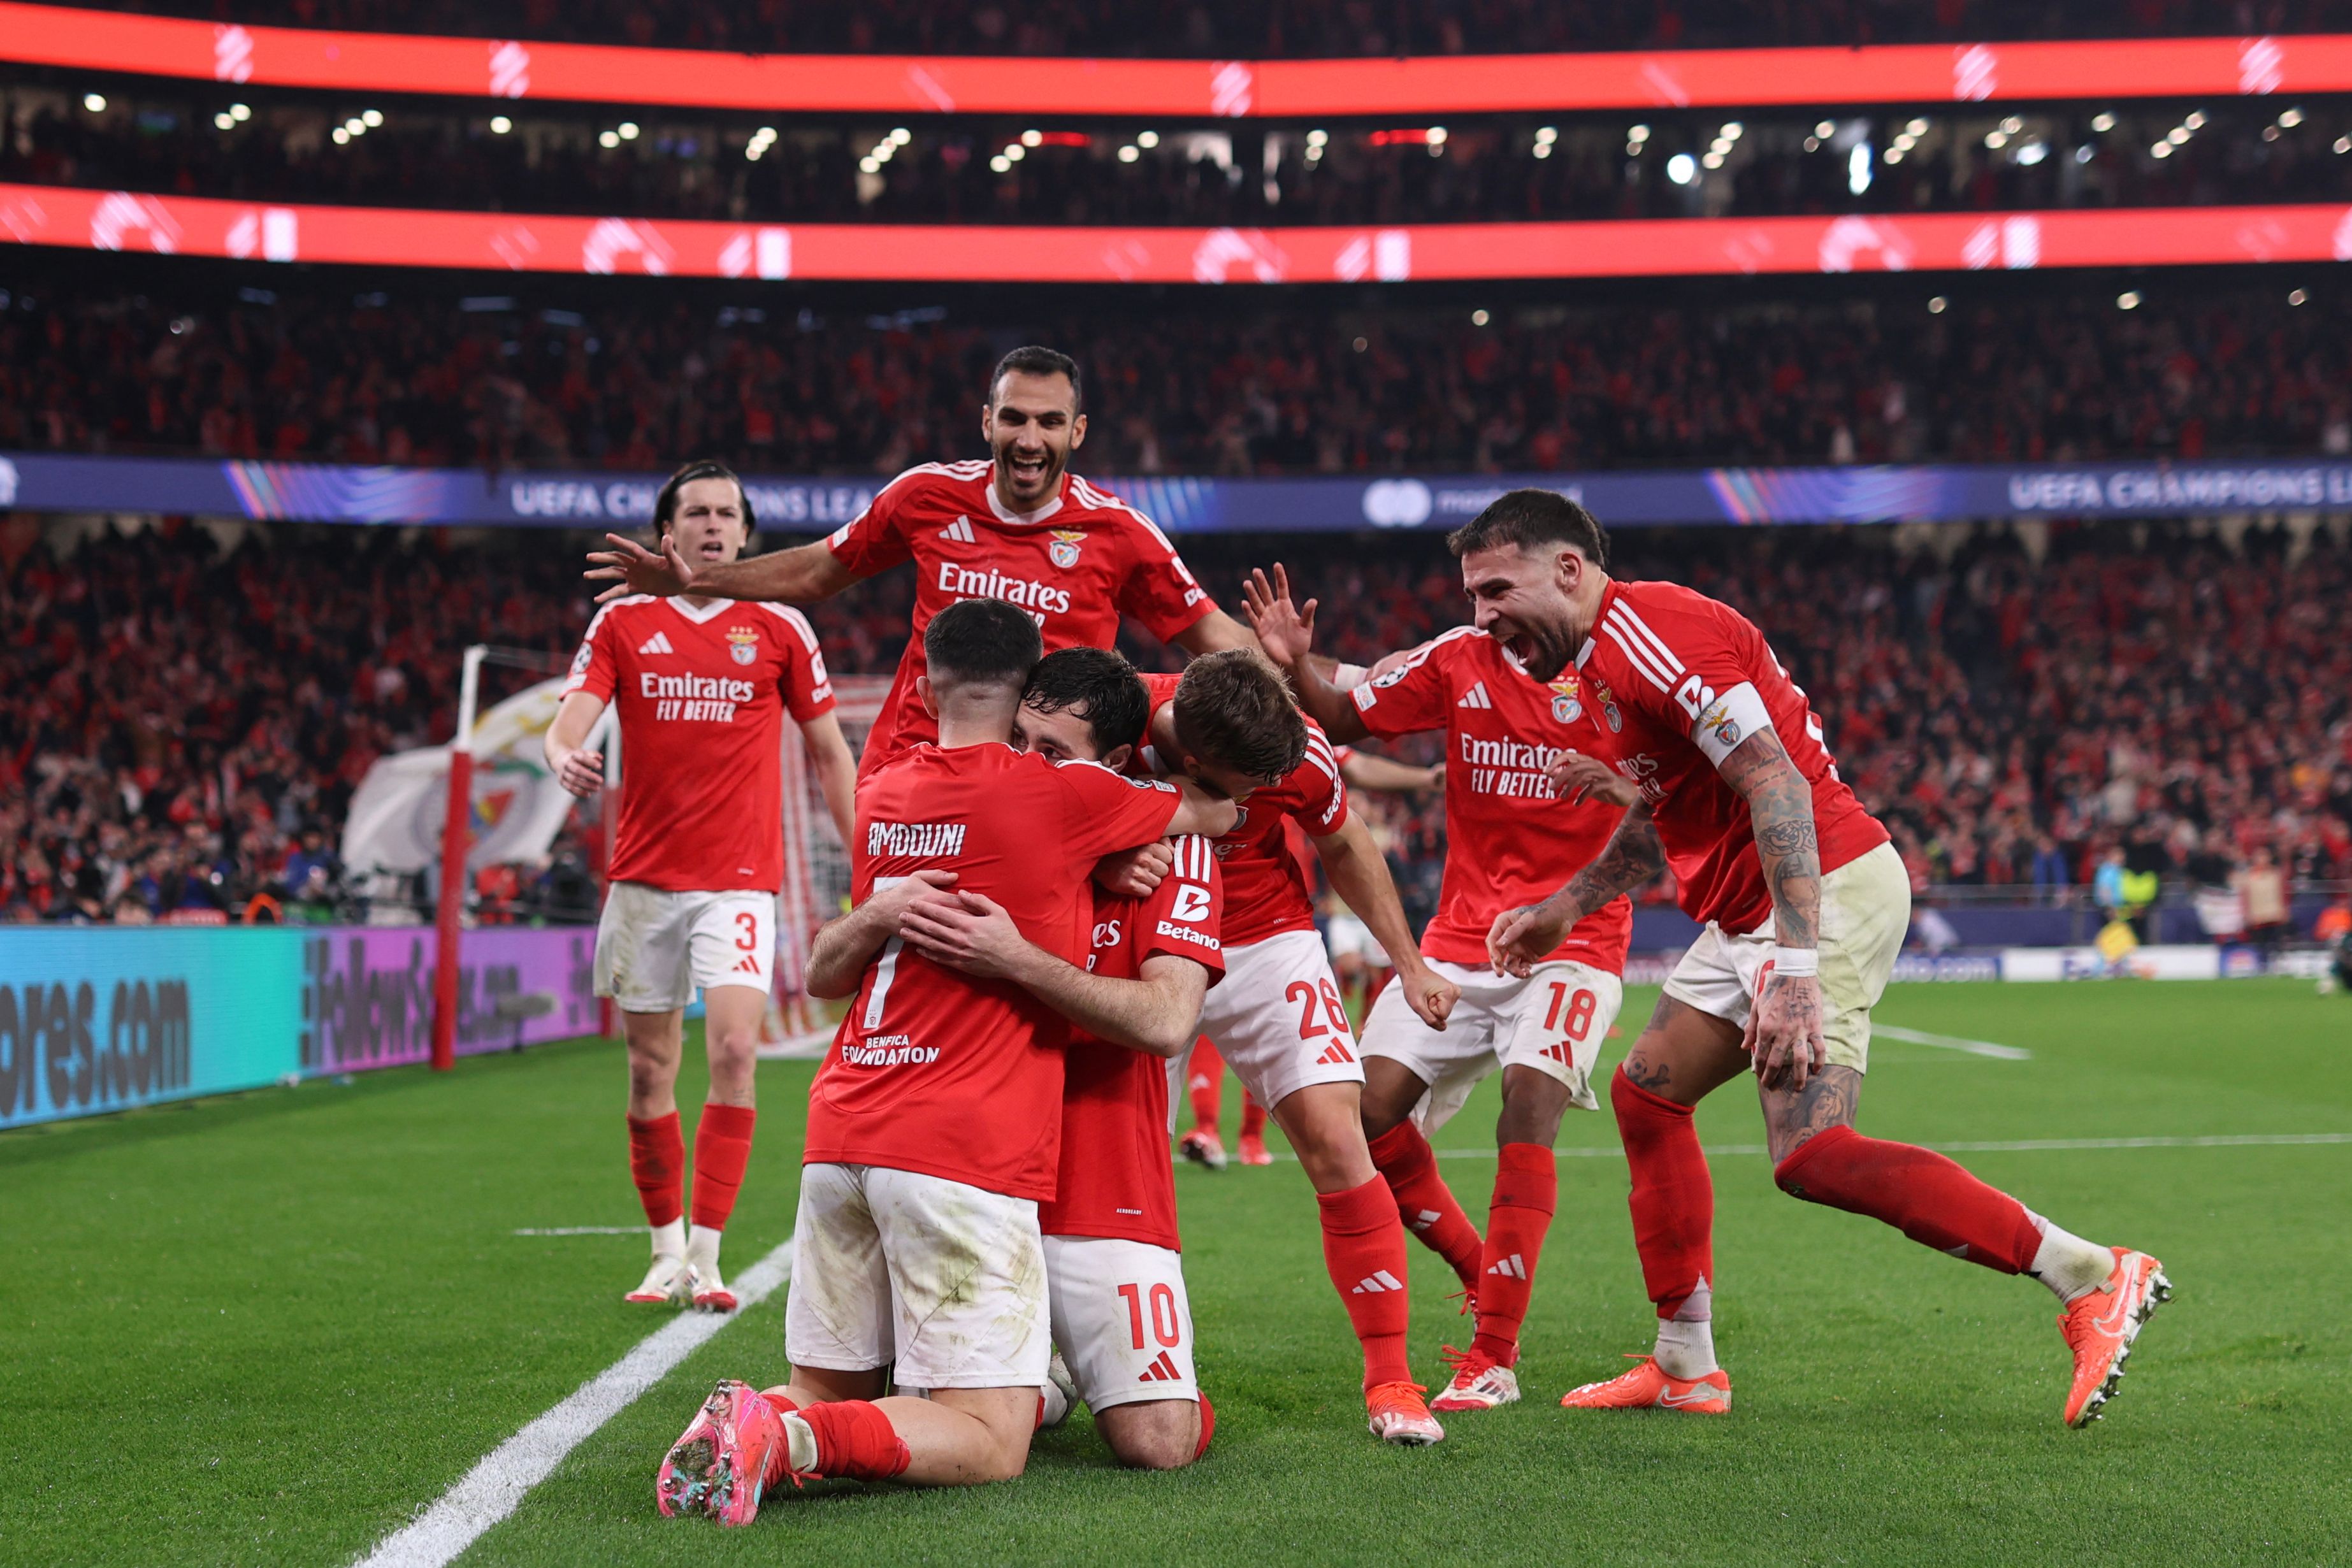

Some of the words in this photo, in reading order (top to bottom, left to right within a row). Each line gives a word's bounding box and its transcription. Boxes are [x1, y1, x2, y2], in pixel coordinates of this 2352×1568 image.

[512, 481, 602, 517] UEFA
[2010, 473, 2102, 510] UEFA
[2107, 469, 2325, 508] CHAMPIONS
[939, 561, 1071, 614] Emirates
[640, 672, 755, 702] Emirates
[656, 699, 682, 721] FLY
[682, 699, 737, 723] BETTER
[1471, 768, 1496, 794] FLY
[868, 822, 966, 856] AMDOUNI
[735, 912, 757, 951] 3
[1156, 921, 1220, 951] Betano
[1285, 977, 1349, 1040] 26
[1543, 982, 1597, 1042] 18
[842, 1046, 940, 1066] FOUNDATION
[866, 1034, 910, 1049] BENFICA
[1117, 1283, 1180, 1350] 10
